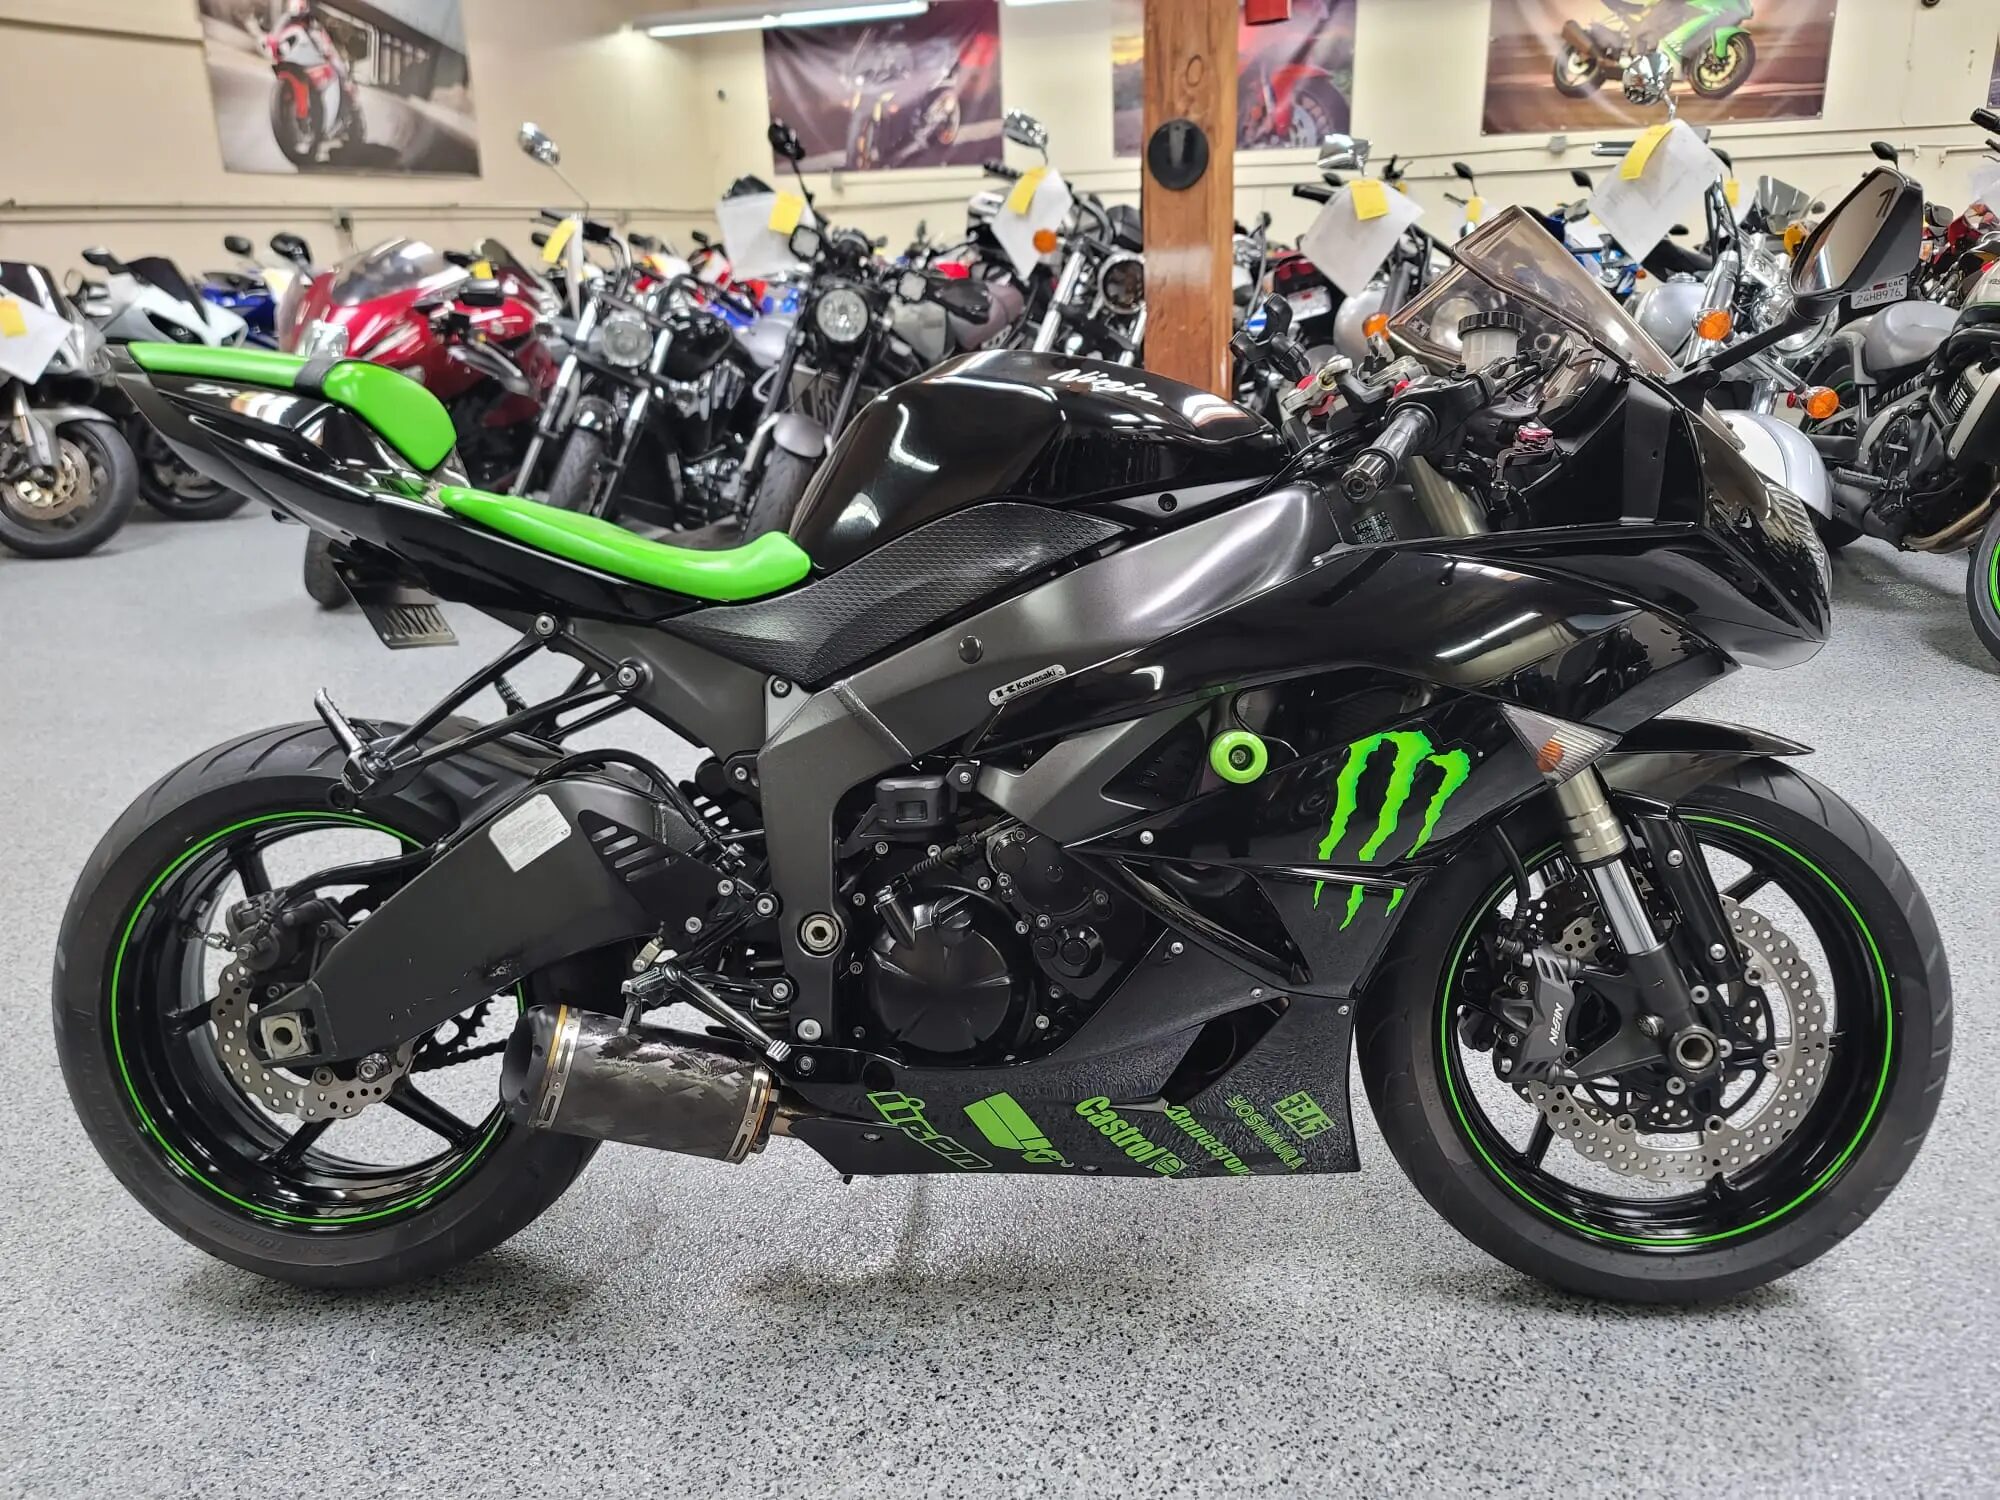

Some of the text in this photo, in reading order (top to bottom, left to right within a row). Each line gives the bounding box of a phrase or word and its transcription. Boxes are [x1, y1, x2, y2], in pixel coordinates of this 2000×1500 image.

[1047, 368, 1165, 407] Ninja
[1016, 669, 1056, 690] Kawasaki
[1548, 1001, 1564, 1046] NISSIN
[1074, 1095, 1168, 1165] Castrol
[1163, 1104, 1256, 1176] BRIDGESTON
[1224, 1094, 1306, 1170] YOSHIMURA
